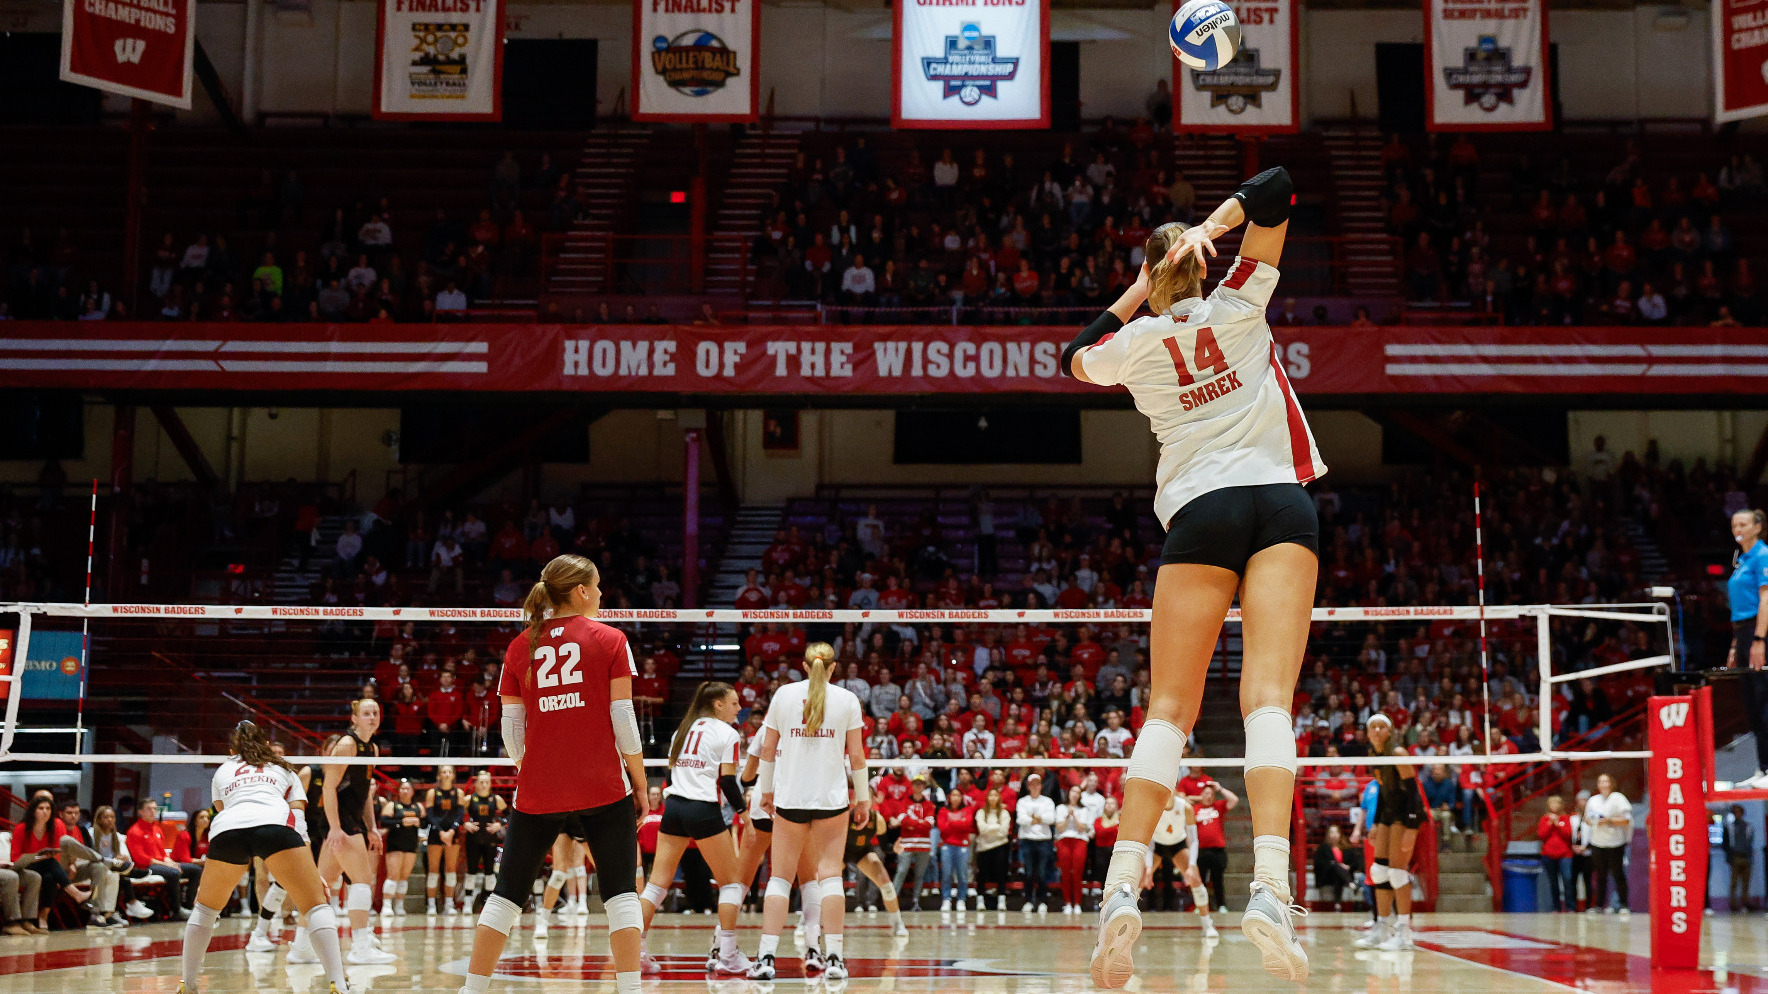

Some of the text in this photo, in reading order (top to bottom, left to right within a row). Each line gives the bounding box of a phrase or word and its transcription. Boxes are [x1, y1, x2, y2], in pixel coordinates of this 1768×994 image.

[1195, 12, 1231, 37] molten
[1235, 7, 1280, 26] LIST
[652, 50, 740, 76] VOLLEYBALL
[929, 62, 1015, 77] CHAMPIONSHIP
[564, 340, 1063, 379] HOME OF THE WISCONS
[1162, 326, 1229, 387] 14
[1178, 370, 1243, 412] SMREK
[112, 606, 206, 615] WISCONSIN BADGERS
[271, 607, 364, 617] WISCONSIN BADGERS
[429, 609, 521, 618] WISCONSIN BADGERS
[597, 610, 678, 619] SCONSIN BADGERS
[742, 610, 834, 619] WISCONSIN BADGERS
[898, 610, 990, 619] WISCONSIN BADGERS
[1053, 611, 1101, 619] WISCONSIN
[534, 642, 583, 689] 22
[539, 692, 585, 713] ORZOL
[1659, 702, 1689, 730] W
[791, 728, 835, 738] FRAKLIN
[684, 731, 703, 755] 11
[676, 758, 706, 769] SHBURN
[1666, 757, 1689, 934] BADGERS
